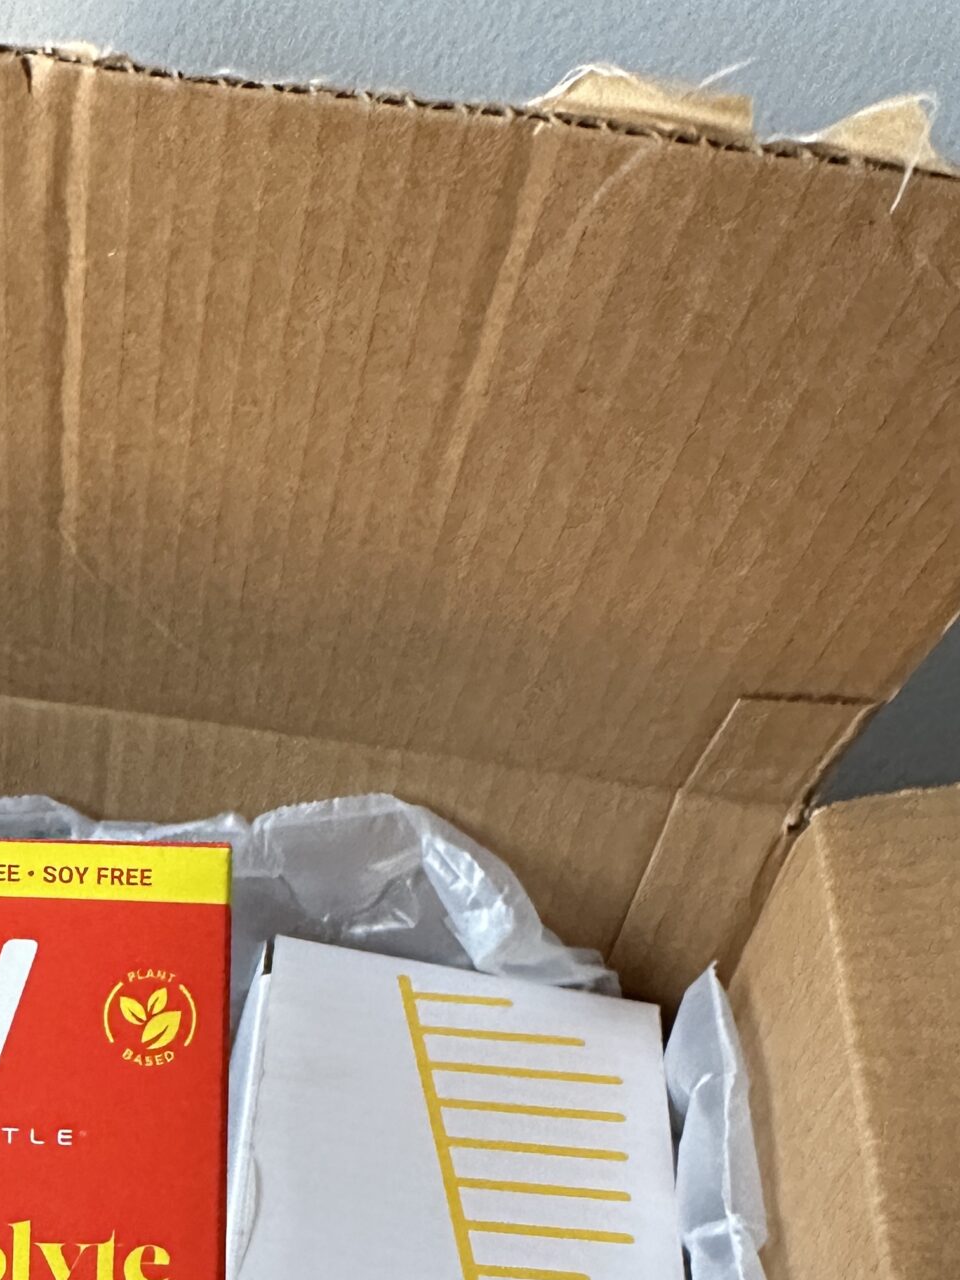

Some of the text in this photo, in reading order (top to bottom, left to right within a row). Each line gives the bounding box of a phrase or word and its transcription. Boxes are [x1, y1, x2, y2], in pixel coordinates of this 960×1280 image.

[44, 866, 88, 884] SOY
[97, 868, 152, 886] FREE
[127, 969, 176, 982] PLANT
[122, 1046, 174, 1066] BASED
